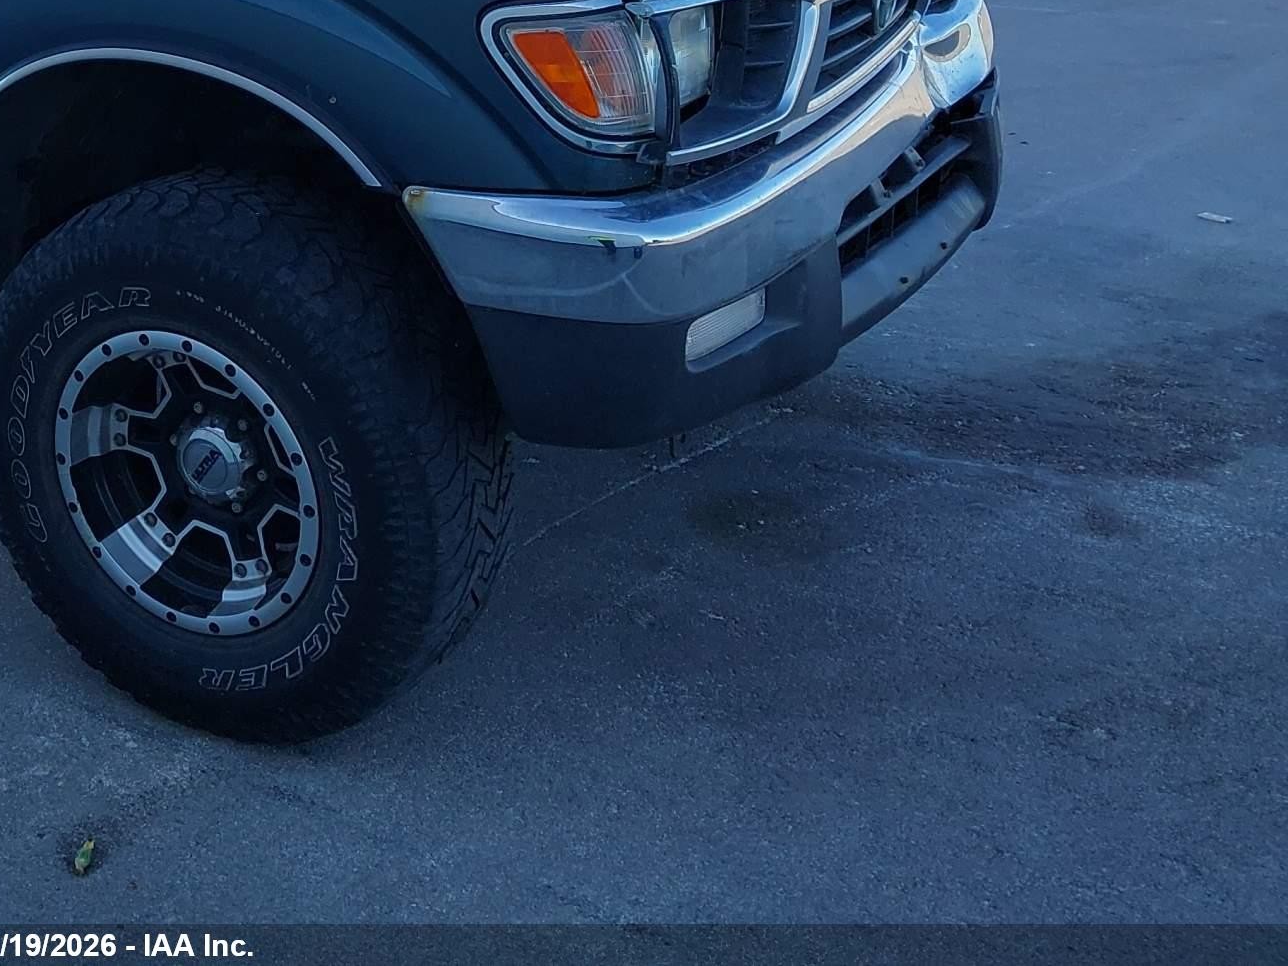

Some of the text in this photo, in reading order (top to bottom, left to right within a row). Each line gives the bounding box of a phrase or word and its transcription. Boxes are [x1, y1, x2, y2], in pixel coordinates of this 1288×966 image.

[7, 286, 152, 544] GOODYEAR
[191, 448, 223, 485] ULTRA
[197, 436, 359, 692] WRANGLER
